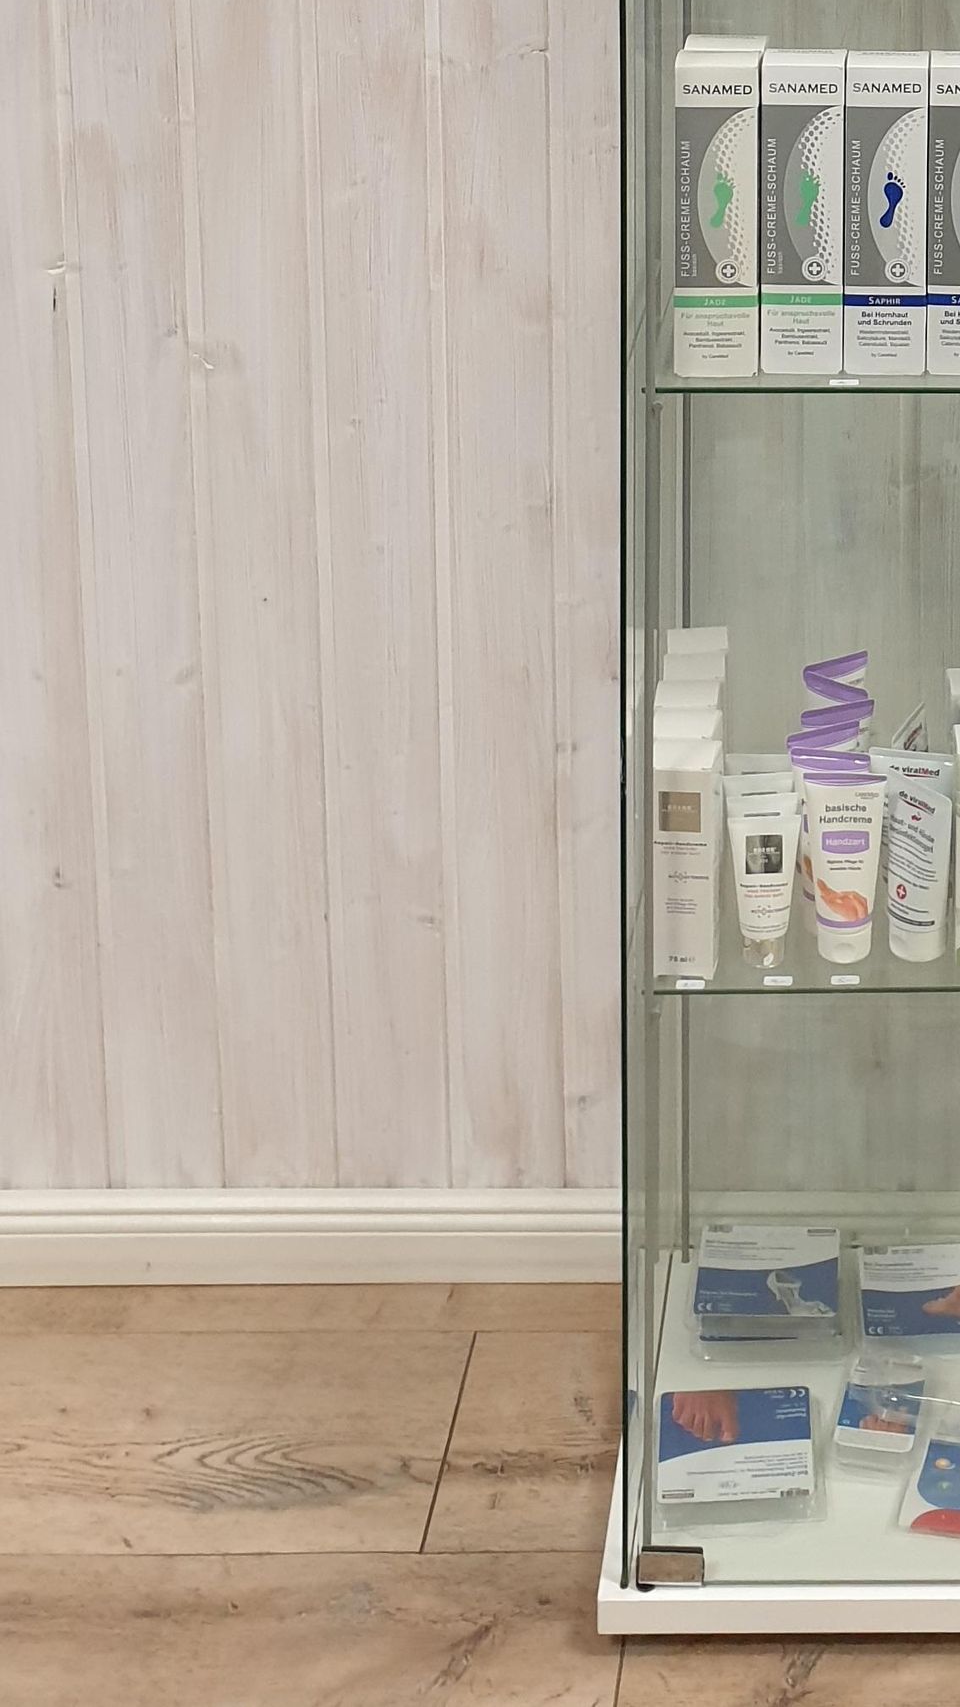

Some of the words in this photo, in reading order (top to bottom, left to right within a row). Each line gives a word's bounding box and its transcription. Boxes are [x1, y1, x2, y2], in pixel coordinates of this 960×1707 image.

[683, 84, 753, 95] SANAMED
[769, 83, 838, 94] SANAMED
[853, 83, 922, 94] SANAMED
[680, 140, 690, 277] FUSS-CREME-SCHAUM
[767, 138, 777, 274] FUSS-CREME-SCHAUM
[850, 140, 861, 276] FUSS-CREME-SCHAUM
[934, 138, 945, 275] FUSS-CREME-SCHAUM
[704, 298, 726, 306] JADE
[790, 296, 812, 304] JADE
[868, 295, 901, 305] SAPHIR
[875, 311, 909, 319] Hornhaut
[944, 310, 957, 318] Bei
[872, 319, 912, 327] Schrunden
[901, 766, 941, 777] viralMed
[825, 803, 867, 813] basische
[819, 815, 873, 824] Handcreme
[825, 837, 866, 846] Handzart
